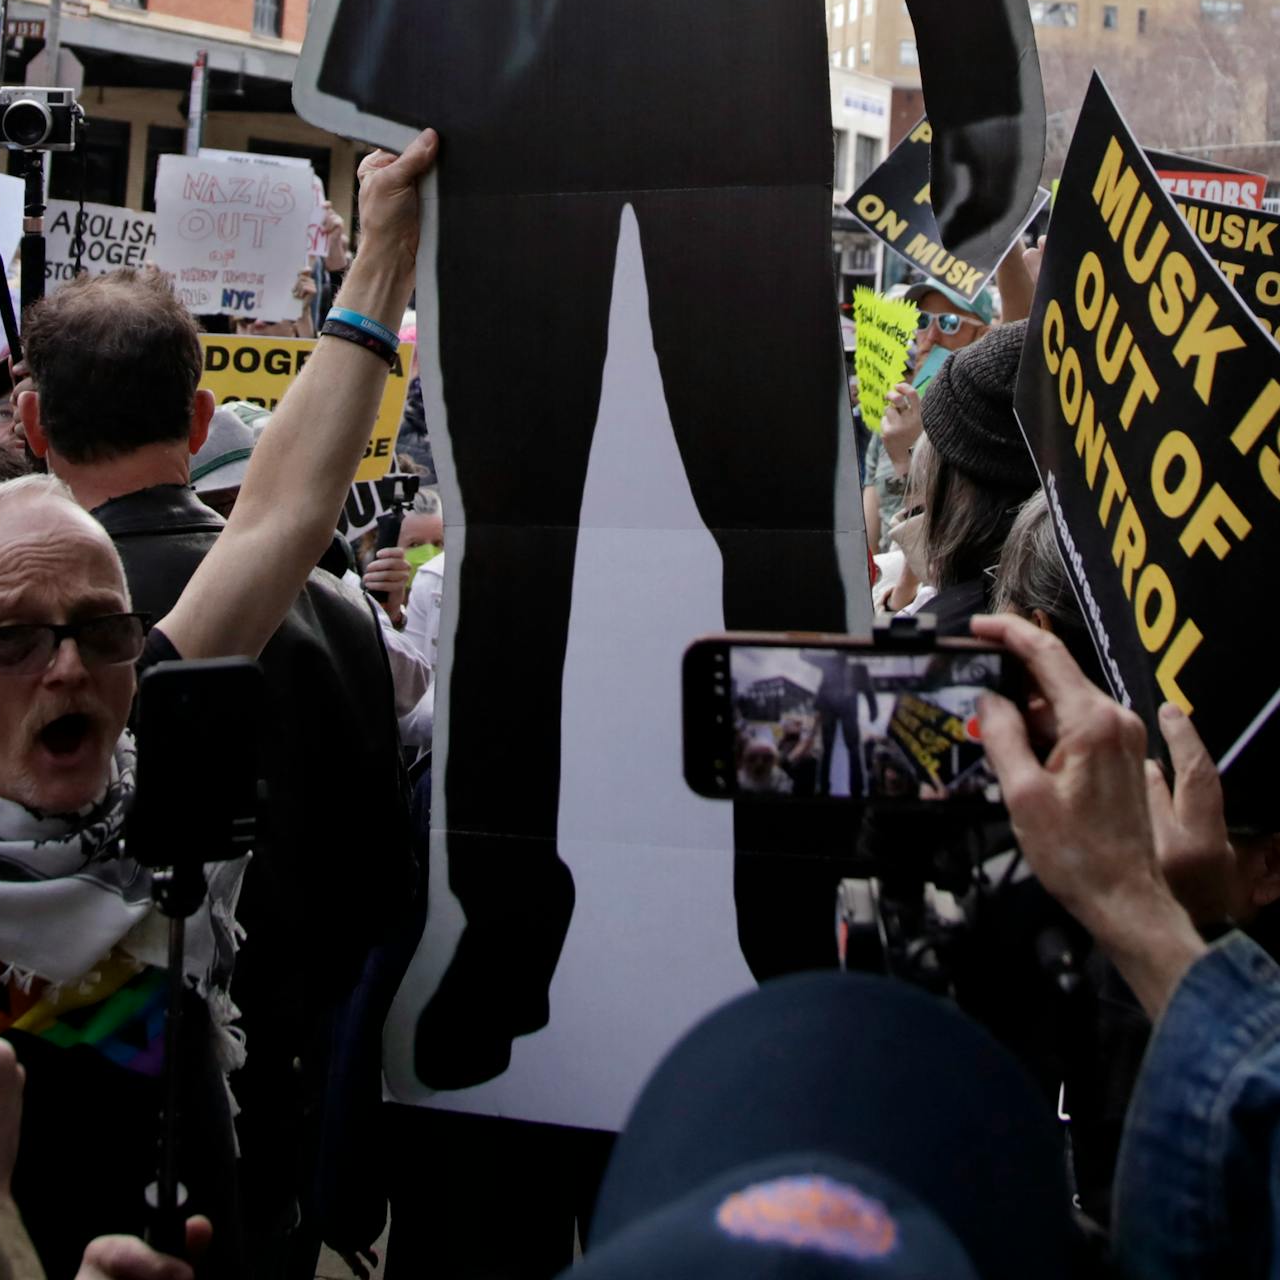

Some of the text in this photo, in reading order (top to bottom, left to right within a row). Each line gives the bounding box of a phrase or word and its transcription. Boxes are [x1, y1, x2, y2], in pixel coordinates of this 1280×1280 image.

[49, 210, 157, 246] ABOLISH
[68, 237, 147, 269] DOGE!
[177, 208, 281, 249] OUT
[856, 193, 910, 242] ON
[903, 233, 985, 295] MUSK
[1091, 134, 1247, 407] MUSK
[1073, 250, 1255, 562] OUT OF
[1041, 297, 1206, 716] CONTROL
